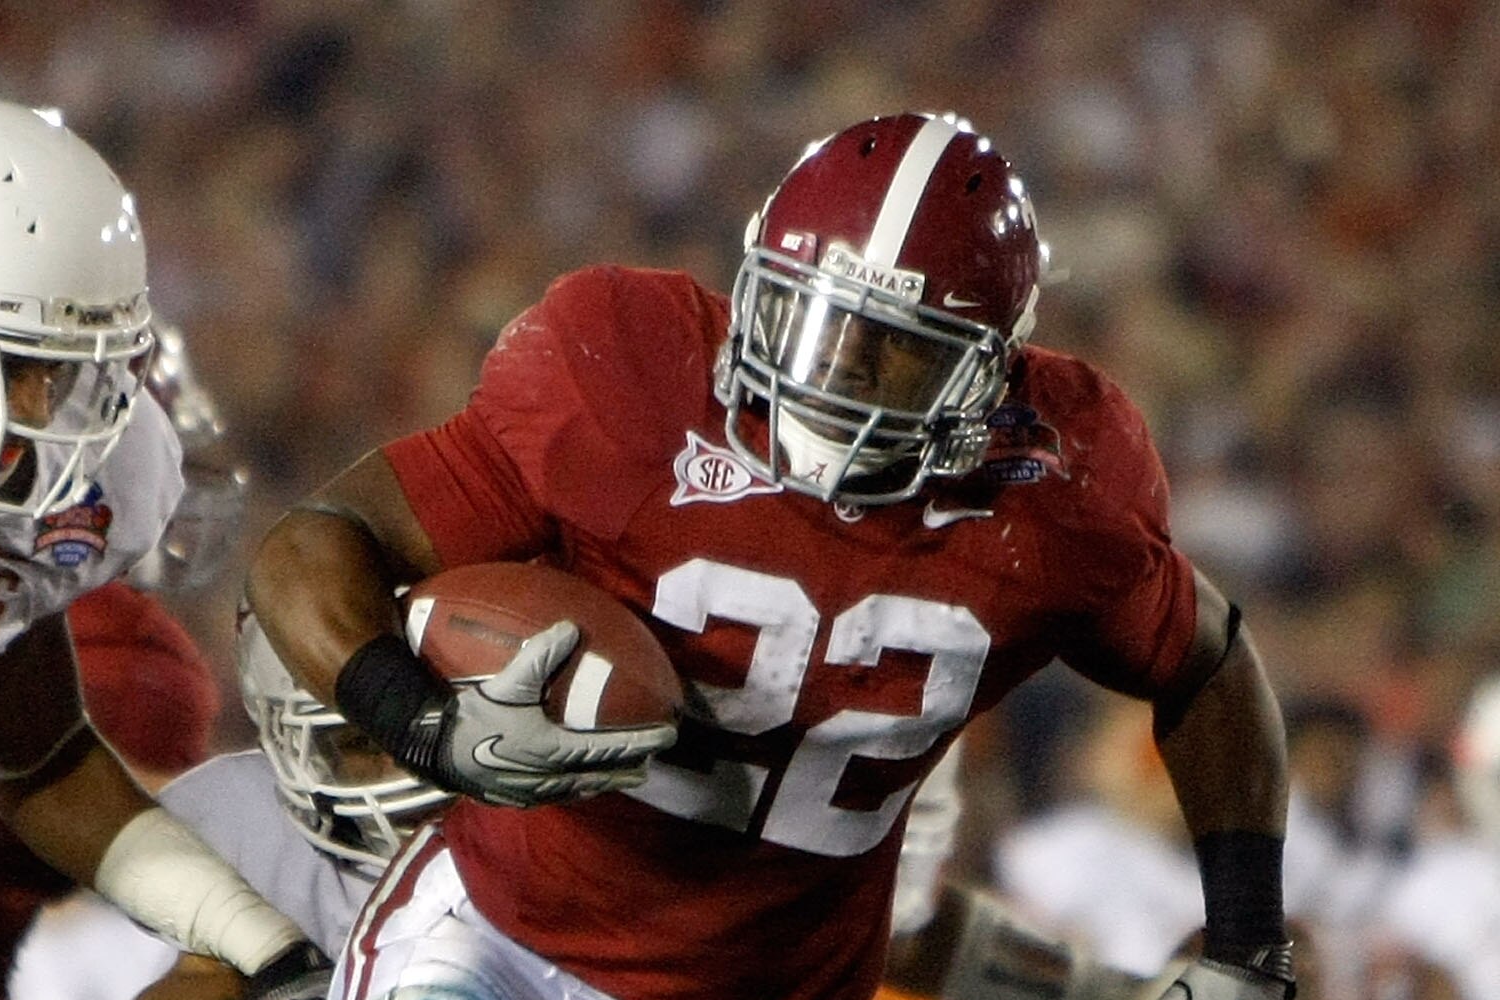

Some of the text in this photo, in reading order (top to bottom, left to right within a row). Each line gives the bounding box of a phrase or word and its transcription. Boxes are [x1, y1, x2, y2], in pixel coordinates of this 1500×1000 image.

[845, 260, 897, 292] BAMA
[699, 456, 735, 492] SEC
[618, 557, 993, 857] 22
